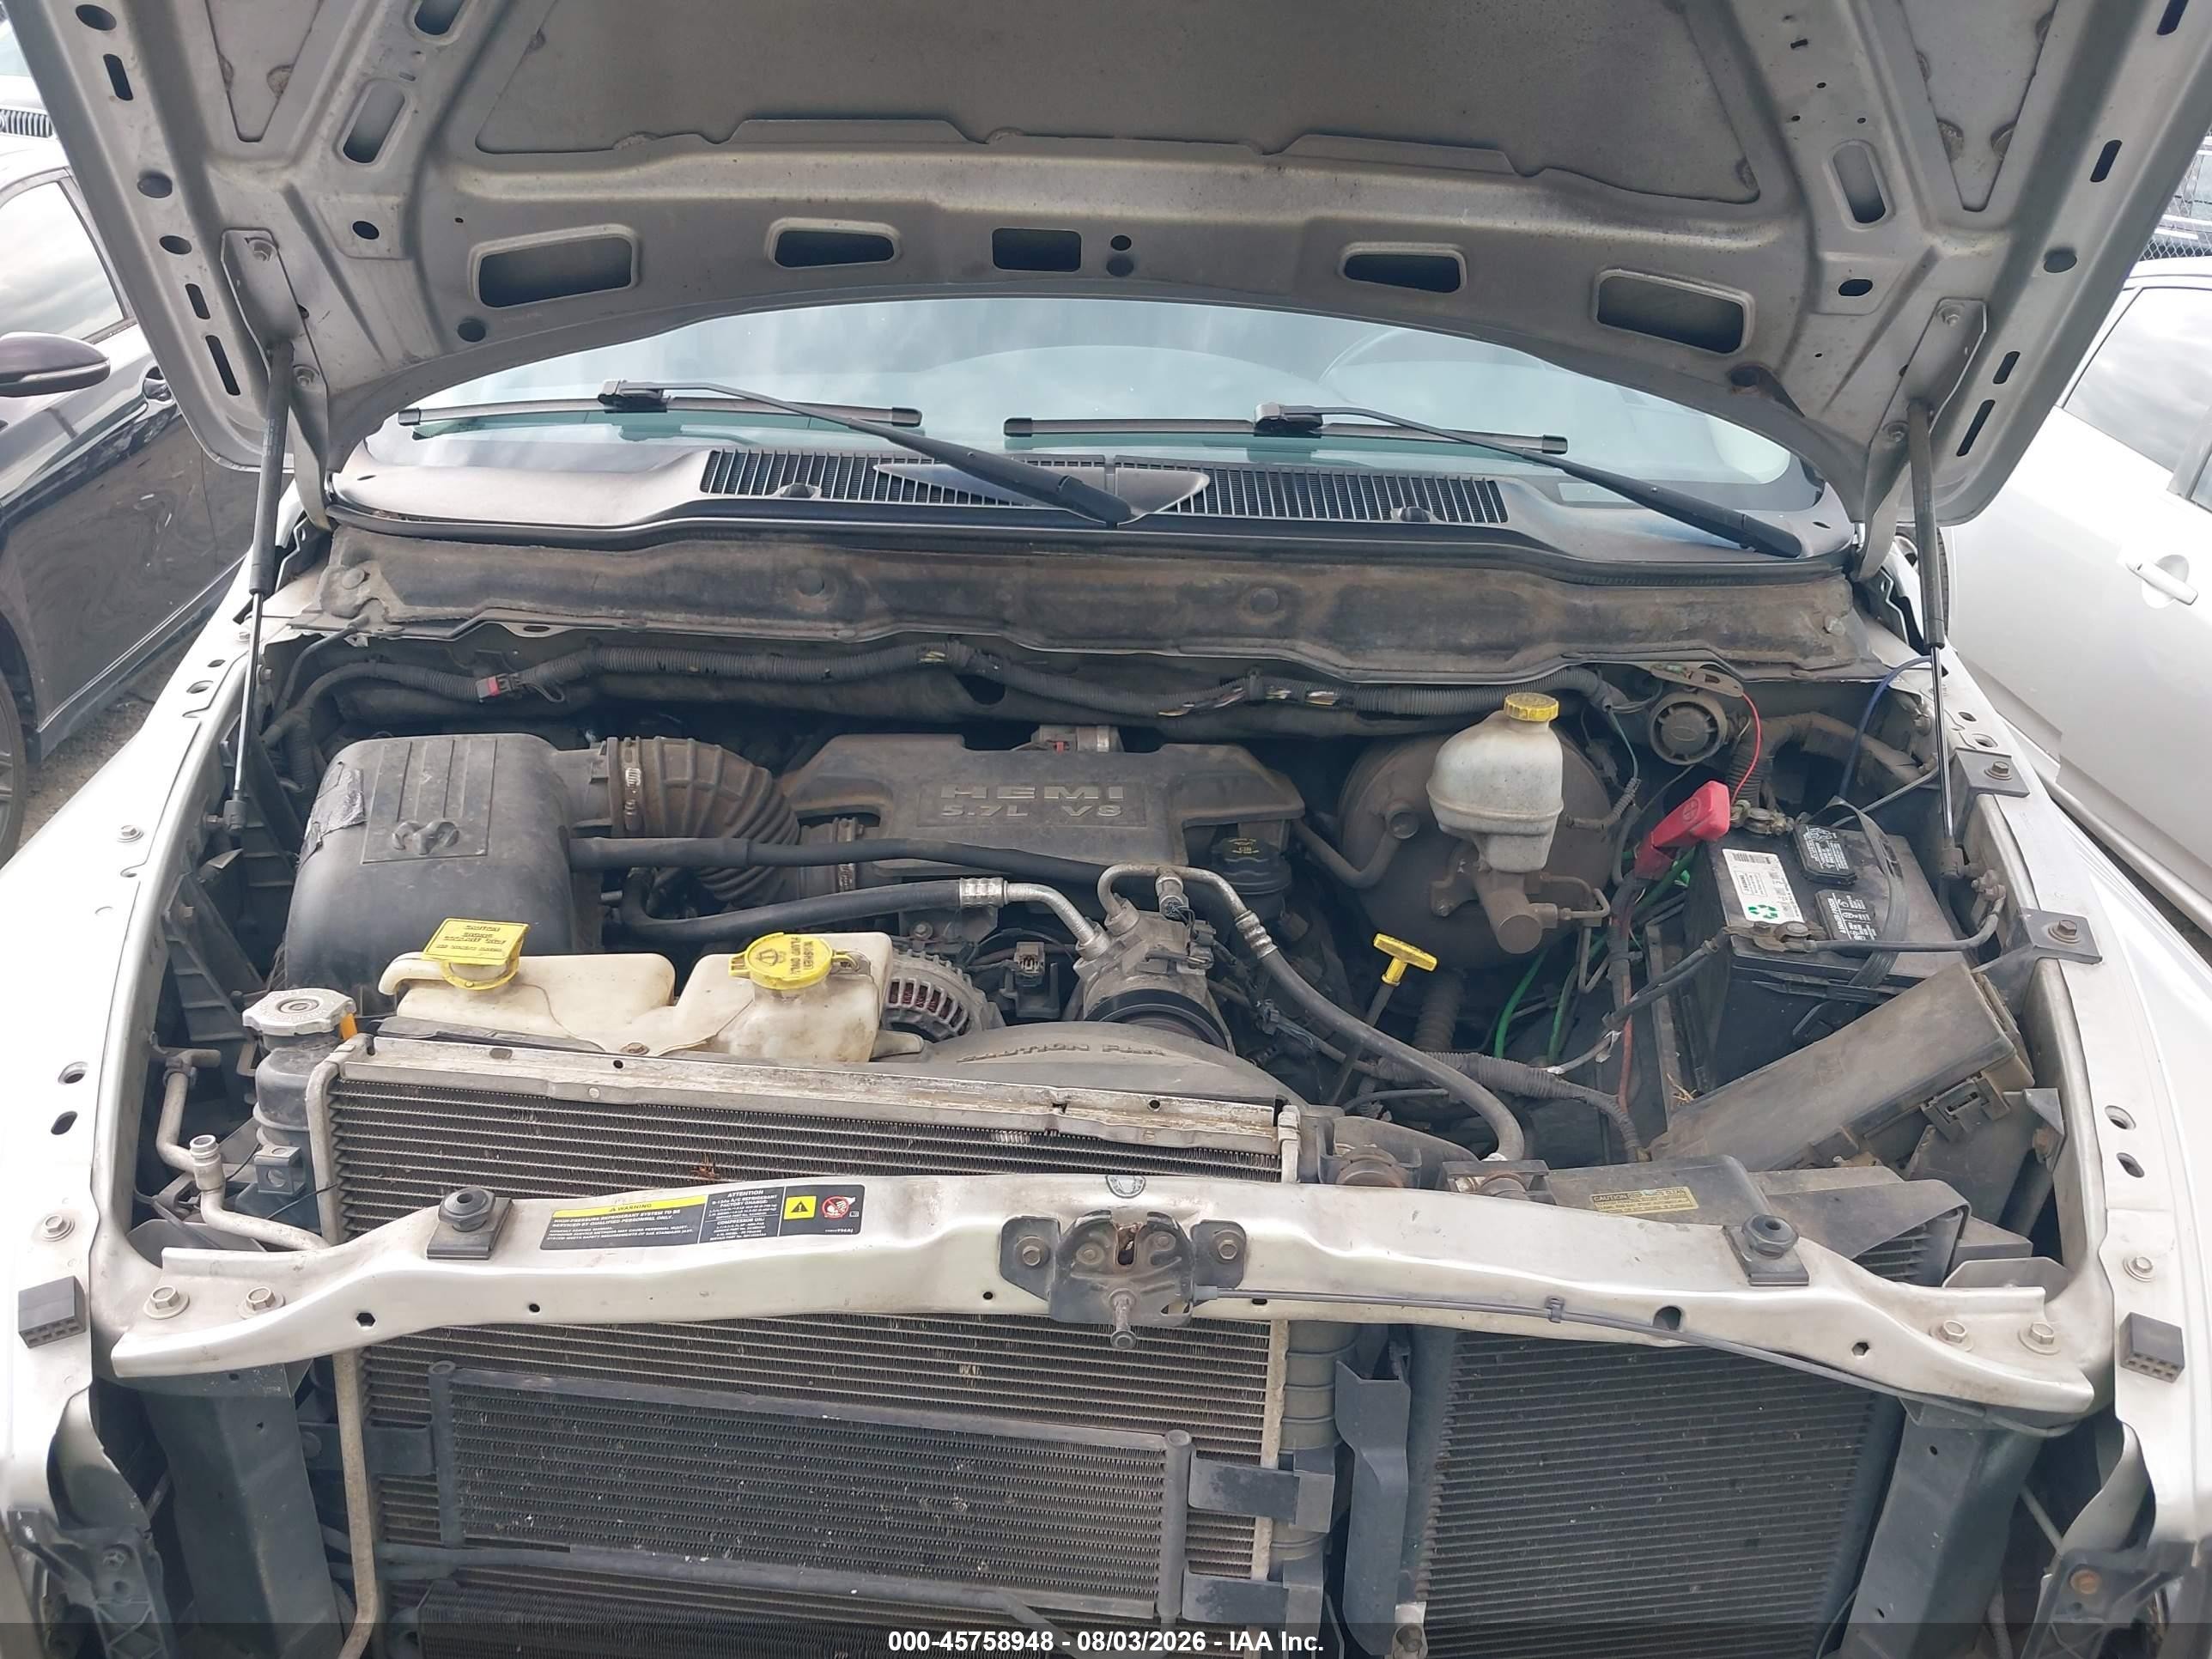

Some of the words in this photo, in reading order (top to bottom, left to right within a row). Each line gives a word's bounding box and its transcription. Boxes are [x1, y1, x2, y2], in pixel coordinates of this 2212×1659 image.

[940, 785, 1124, 800] HEMI
[941, 805, 1029, 817] 5.7L
[1061, 805, 1122, 817] V8
[956, 1042, 1090, 1063] CAUTION
[727, 1189, 764, 1198] ATTENTION
[1593, 1193, 1628, 1202] CAUTION
